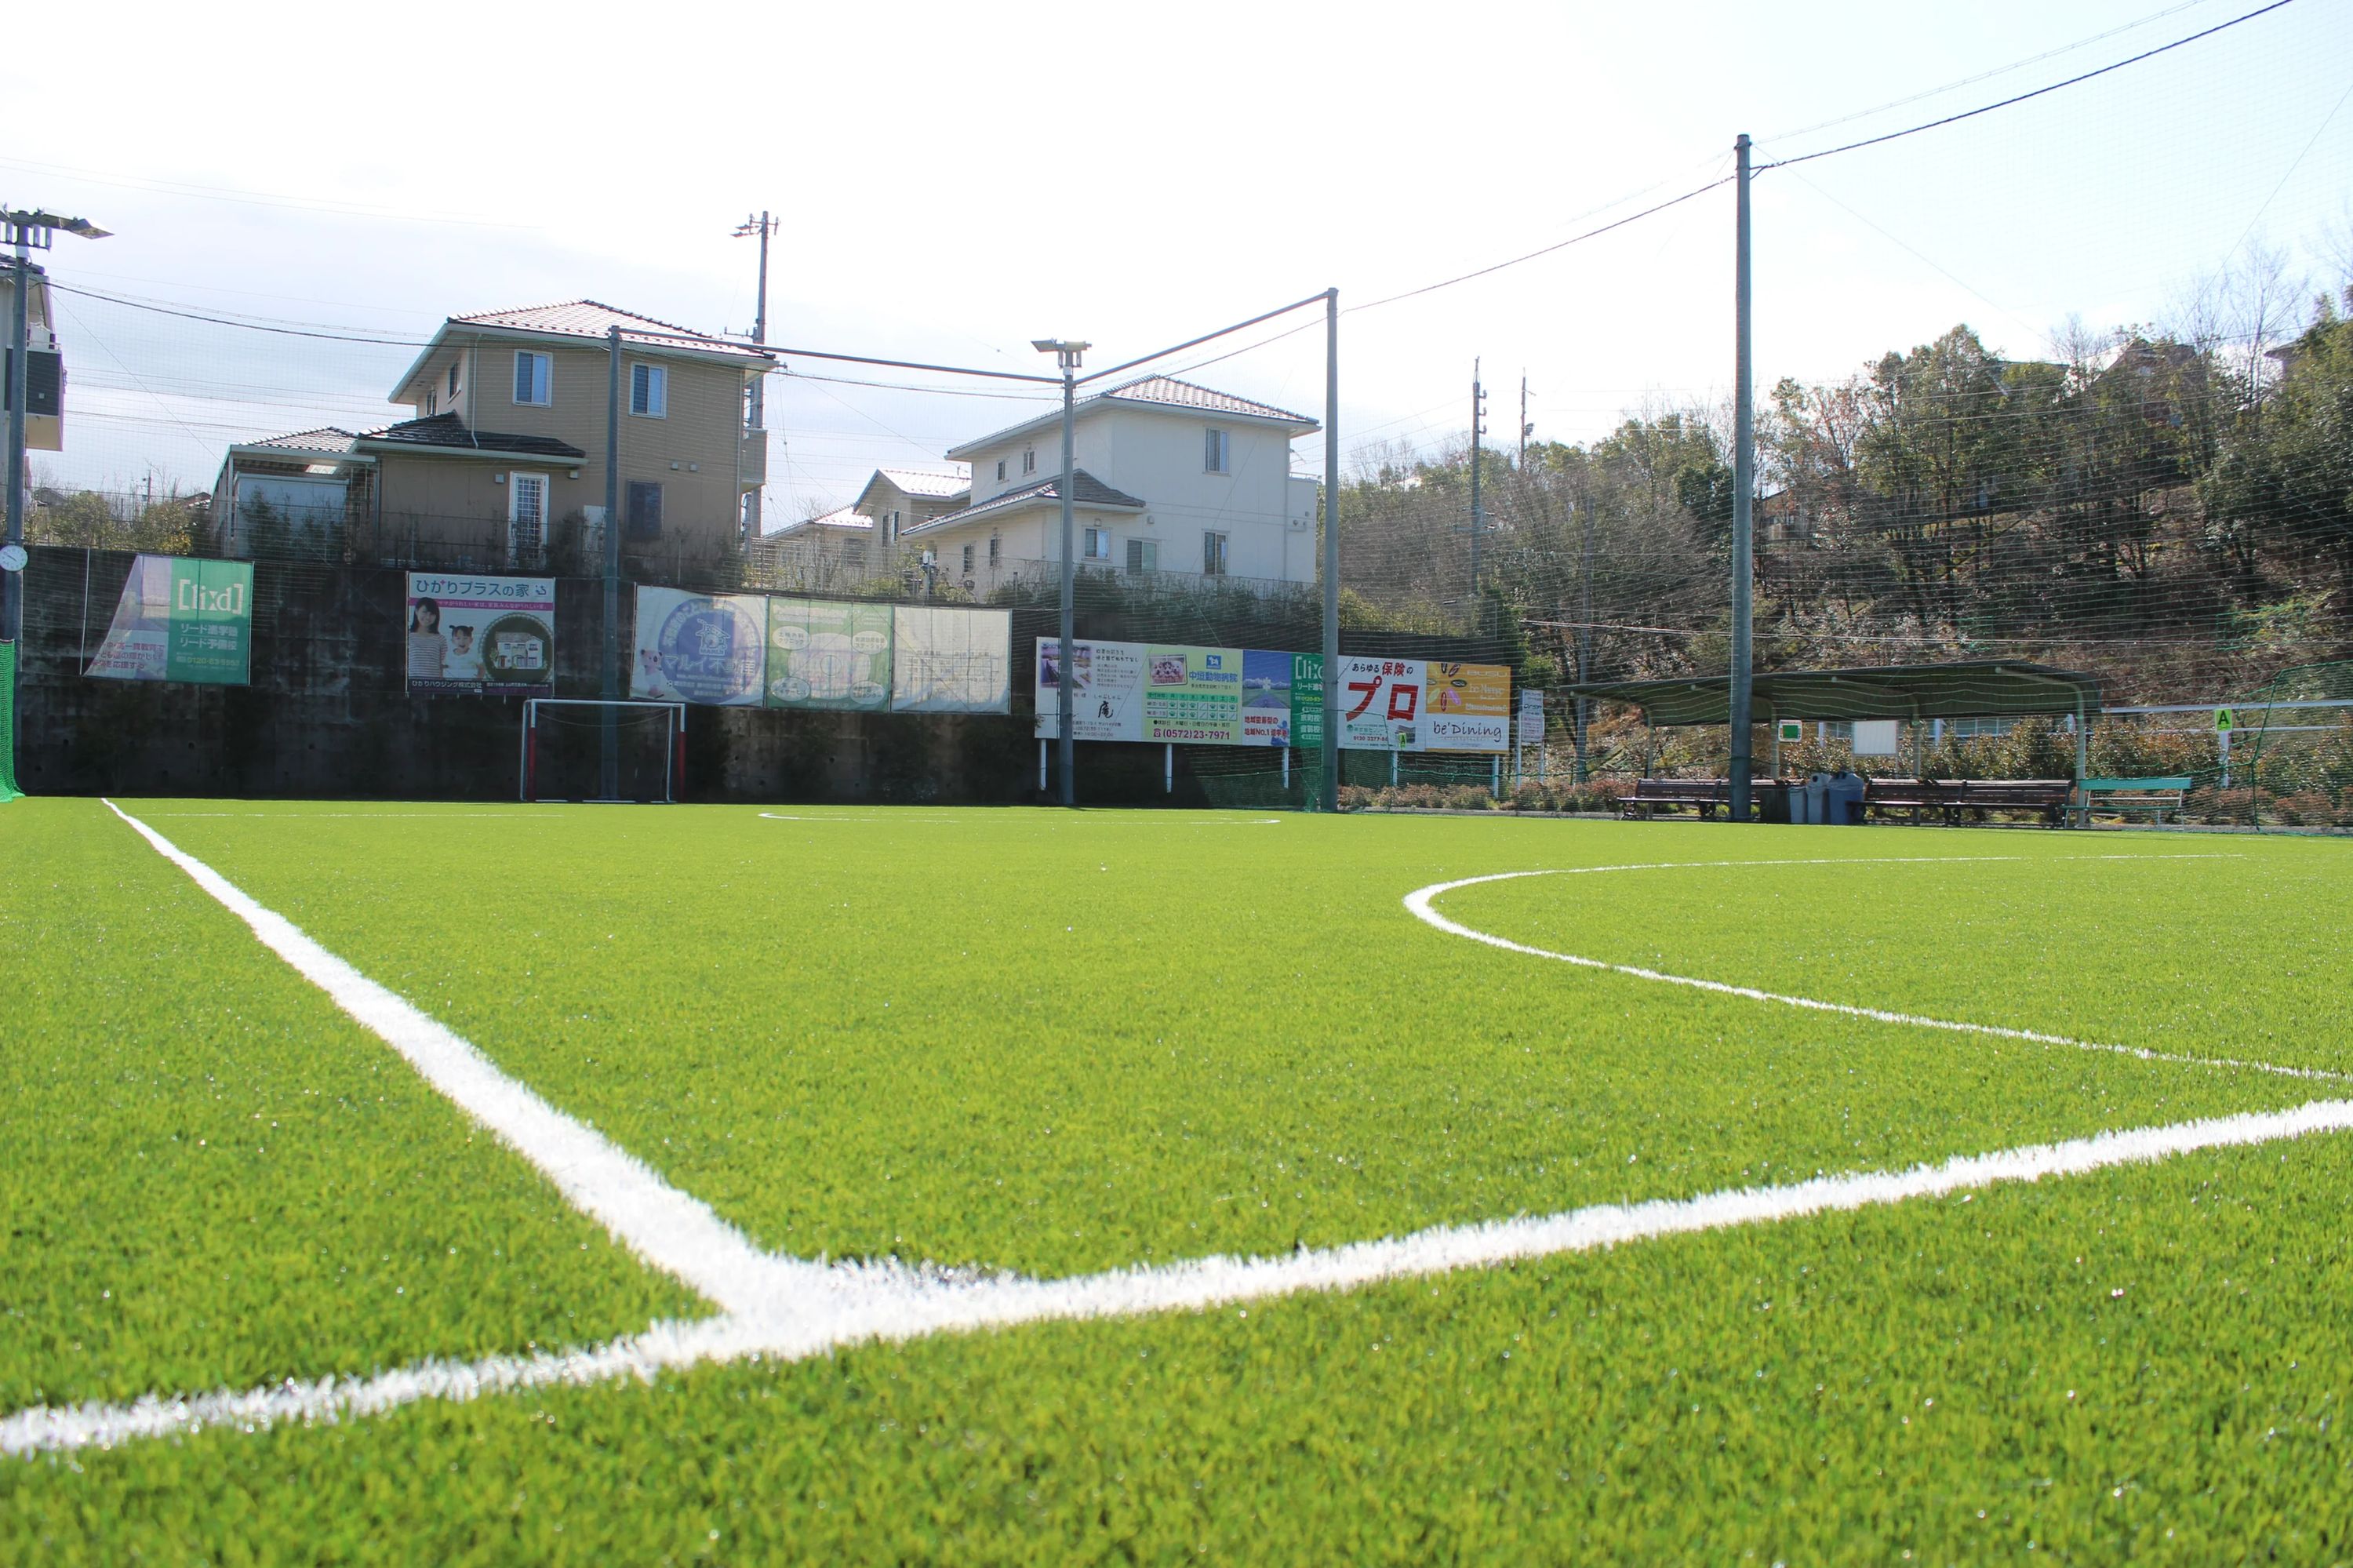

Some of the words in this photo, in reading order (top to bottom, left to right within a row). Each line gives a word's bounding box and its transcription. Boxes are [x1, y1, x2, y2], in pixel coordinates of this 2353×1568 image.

[416, 579, 529, 598] ひかりプラスの家
[1351, 661, 1413, 677] あらゆる保険の
[1345, 675, 1419, 722] プロ
[2218, 710, 2230, 725] A
[1163, 729, 1230, 740] (0572)23-7971
[1400, 734, 1406, 744] A
[1433, 721, 1502, 743] be'Dining
